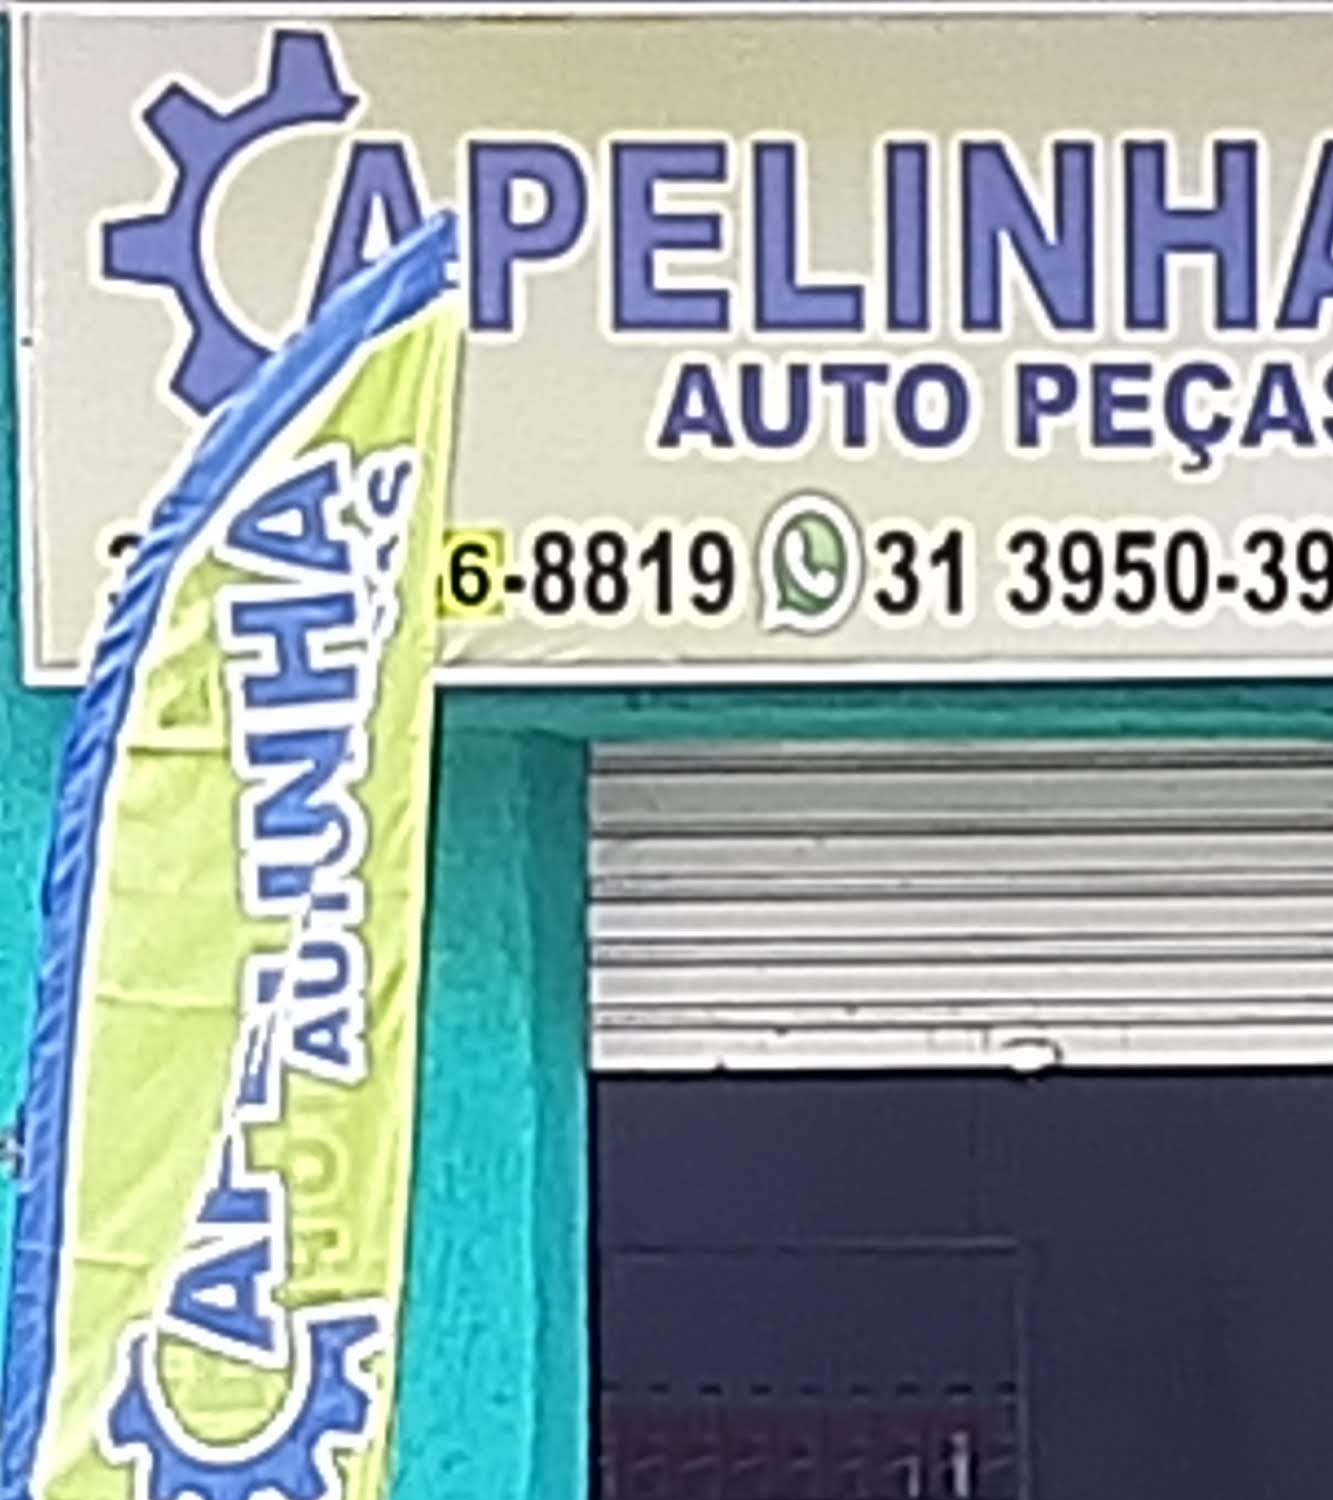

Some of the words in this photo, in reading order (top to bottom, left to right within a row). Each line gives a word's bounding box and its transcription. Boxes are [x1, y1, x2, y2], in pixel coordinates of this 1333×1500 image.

[657, 362, 970, 450] AUTO
[448, 529, 736, 616] 6-8819
[874, 530, 964, 615] 31
